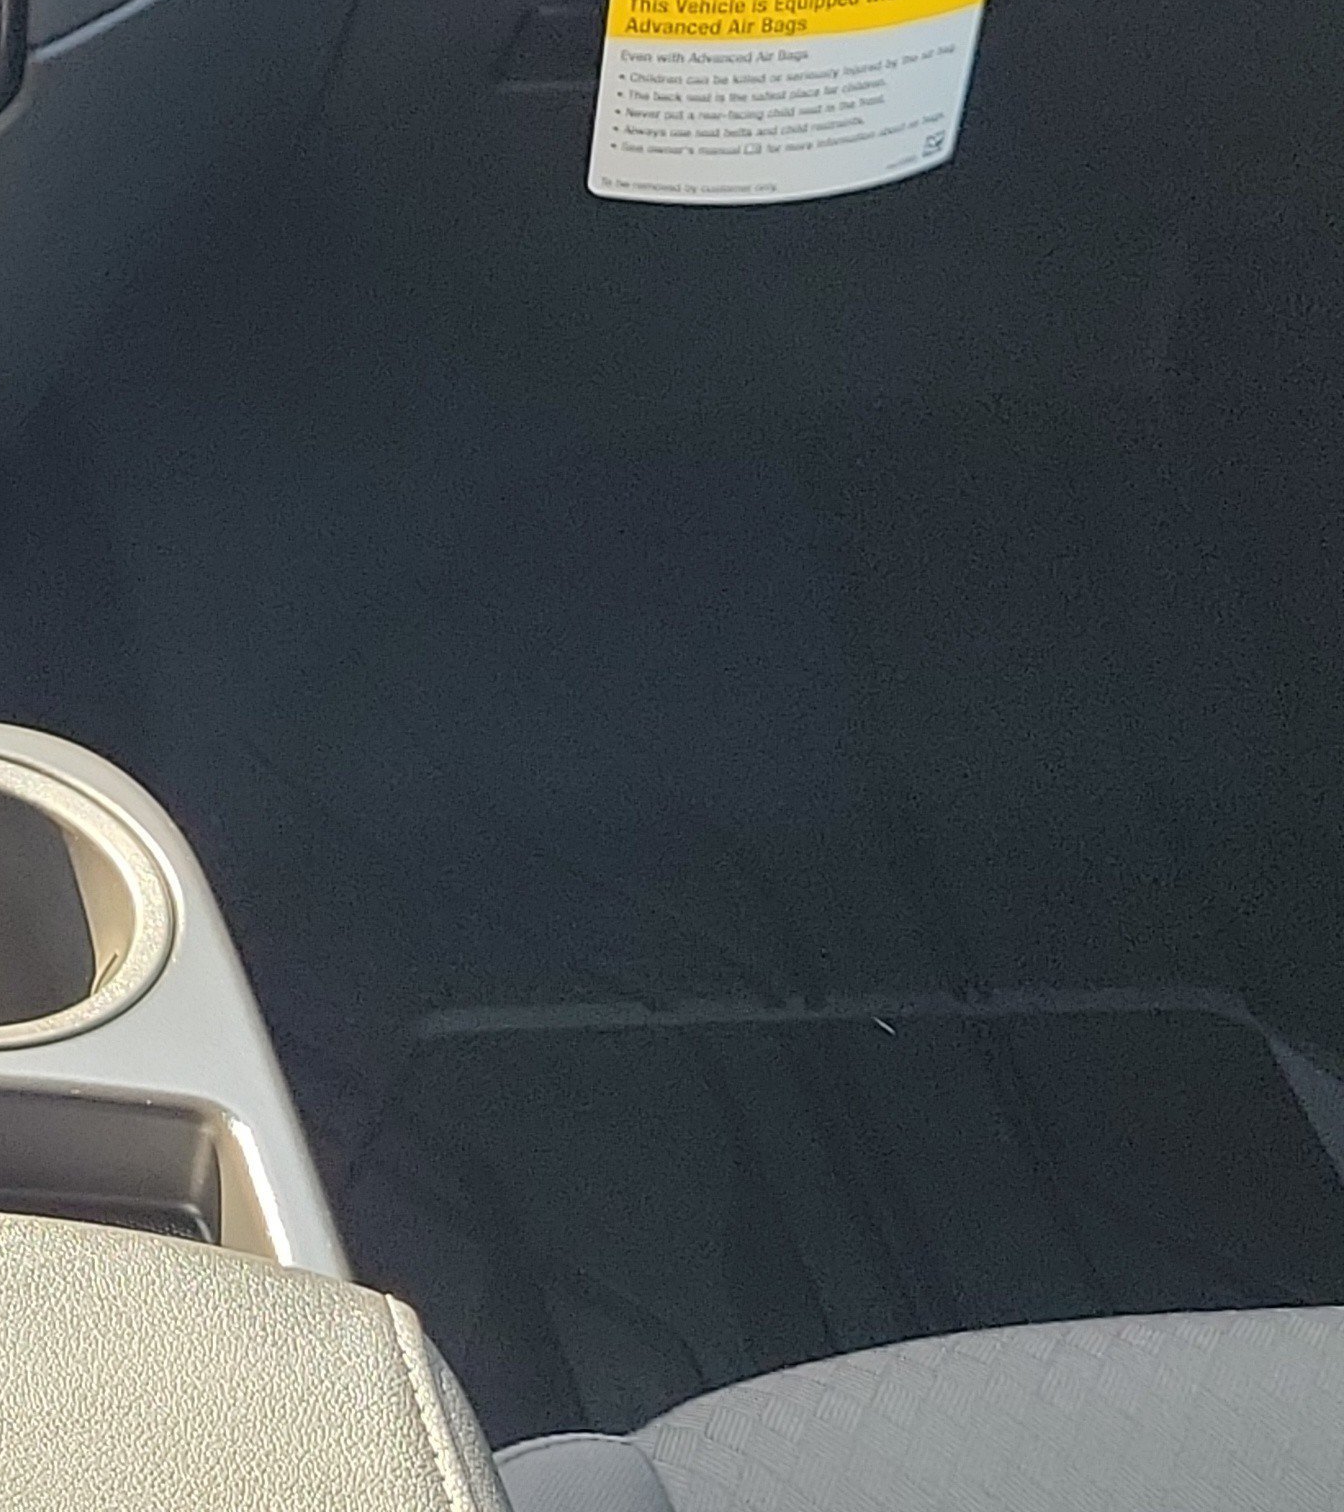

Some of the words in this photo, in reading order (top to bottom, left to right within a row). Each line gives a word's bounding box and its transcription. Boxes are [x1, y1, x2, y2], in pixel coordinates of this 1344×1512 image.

[624, 16, 722, 36] Advanced
[726, 18, 756, 35] Air
[761, 16, 808, 37] Bags
[620, 49, 653, 63] Even
[656, 49, 685, 64] with
[688, 50, 753, 65] Advanced
[756, 49, 775, 63] Air
[778, 49, 809, 64] Bags
